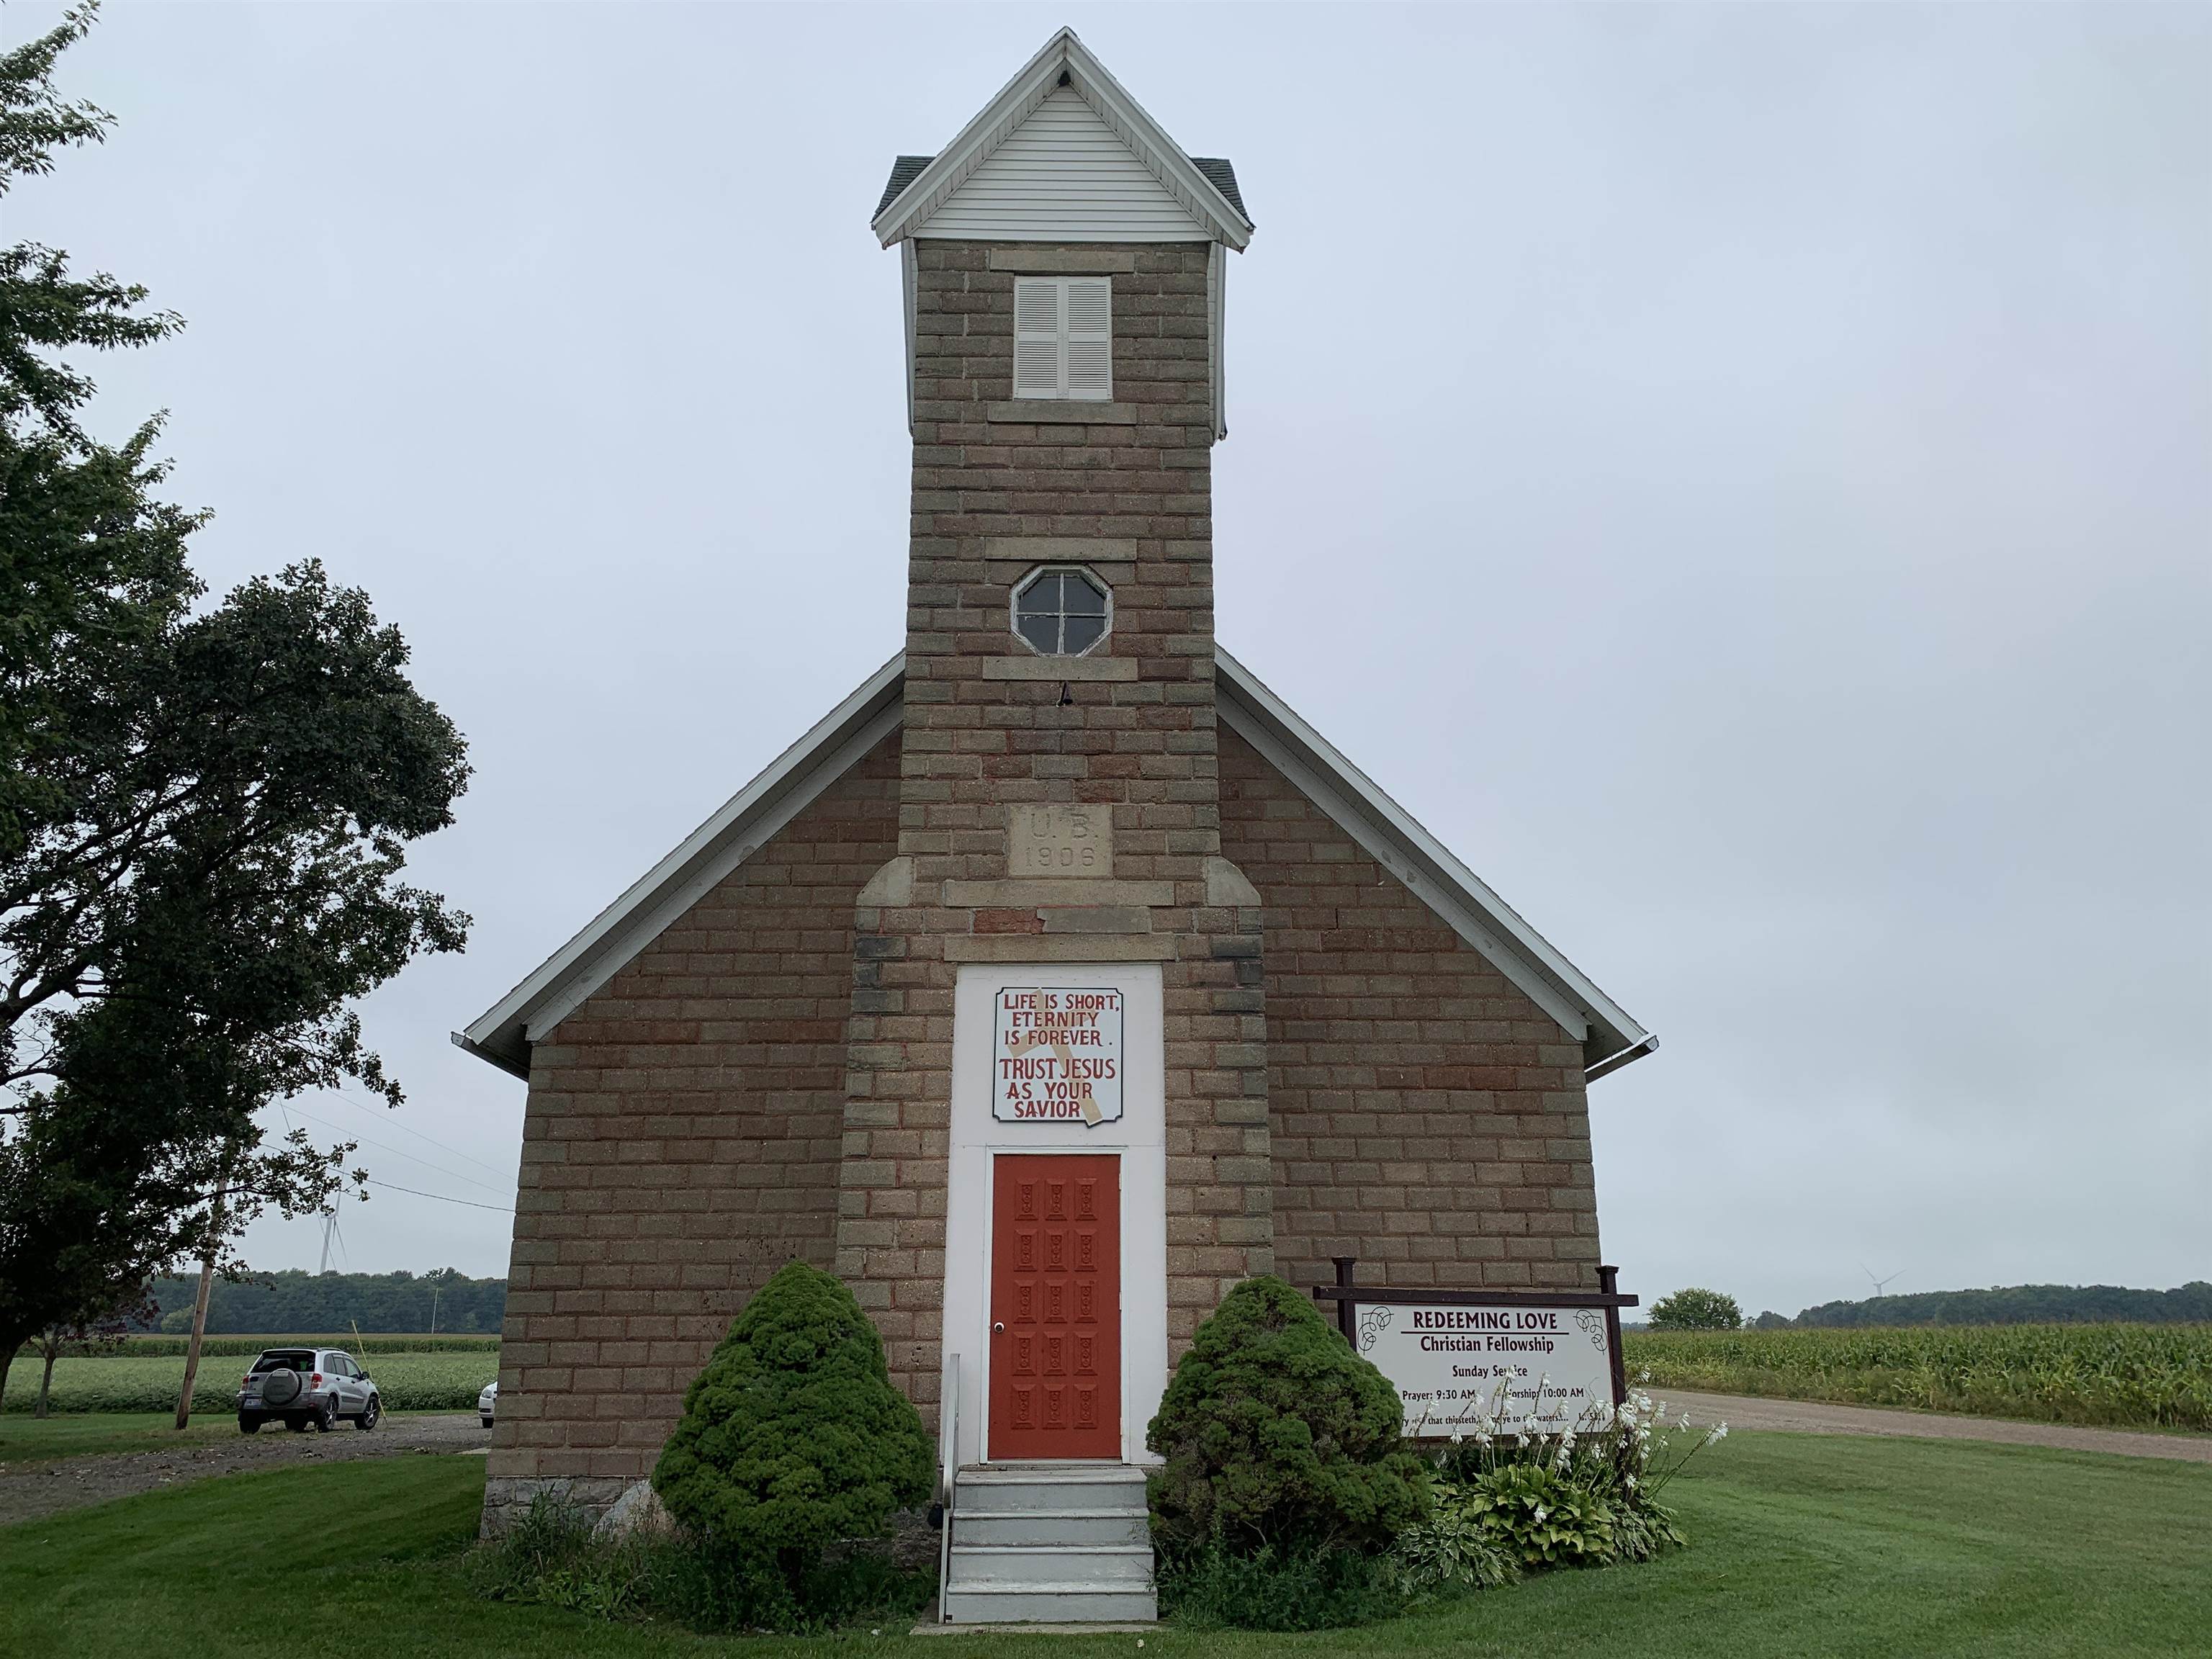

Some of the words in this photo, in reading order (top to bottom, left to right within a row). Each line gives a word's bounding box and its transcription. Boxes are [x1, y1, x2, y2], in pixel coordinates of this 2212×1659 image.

[1027, 847, 1095, 867] 1906
[1004, 994, 1038, 1010] LIFE
[1045, 994, 1058, 1010] IS
[1066, 994, 1119, 1012] SHORT,
[1012, 1012, 1100, 1027] ETERNITY
[1004, 1030, 1020, 1046] IS
[999, 1058, 1058, 1079] TRUST
[1059, 1058, 1116, 1079] JESUS
[1004, 1082, 1033, 1100] AS
[1044, 1082, 1093, 1100] YOUR
[1014, 1100, 1081, 1118] SAVIOR
[1413, 1311, 1511, 1329] REDEEMING
[1516, 1313, 1557, 1330] LOVE
[1421, 1335, 1481, 1352] Christian
[1486, 1336, 1555, 1354] Fellowship
[1452, 1364, 1489, 1379] Sunday
[1403, 1390, 1433, 1402] Prayer:
[1436, 1390, 1457, 1400] 9:30
[1460, 1389, 1475, 1399] AM
[1544, 1388, 1567, 1398] 10:00
[1570, 1388, 1584, 1398] AM
[1502, 1416, 1511, 1424] ye
